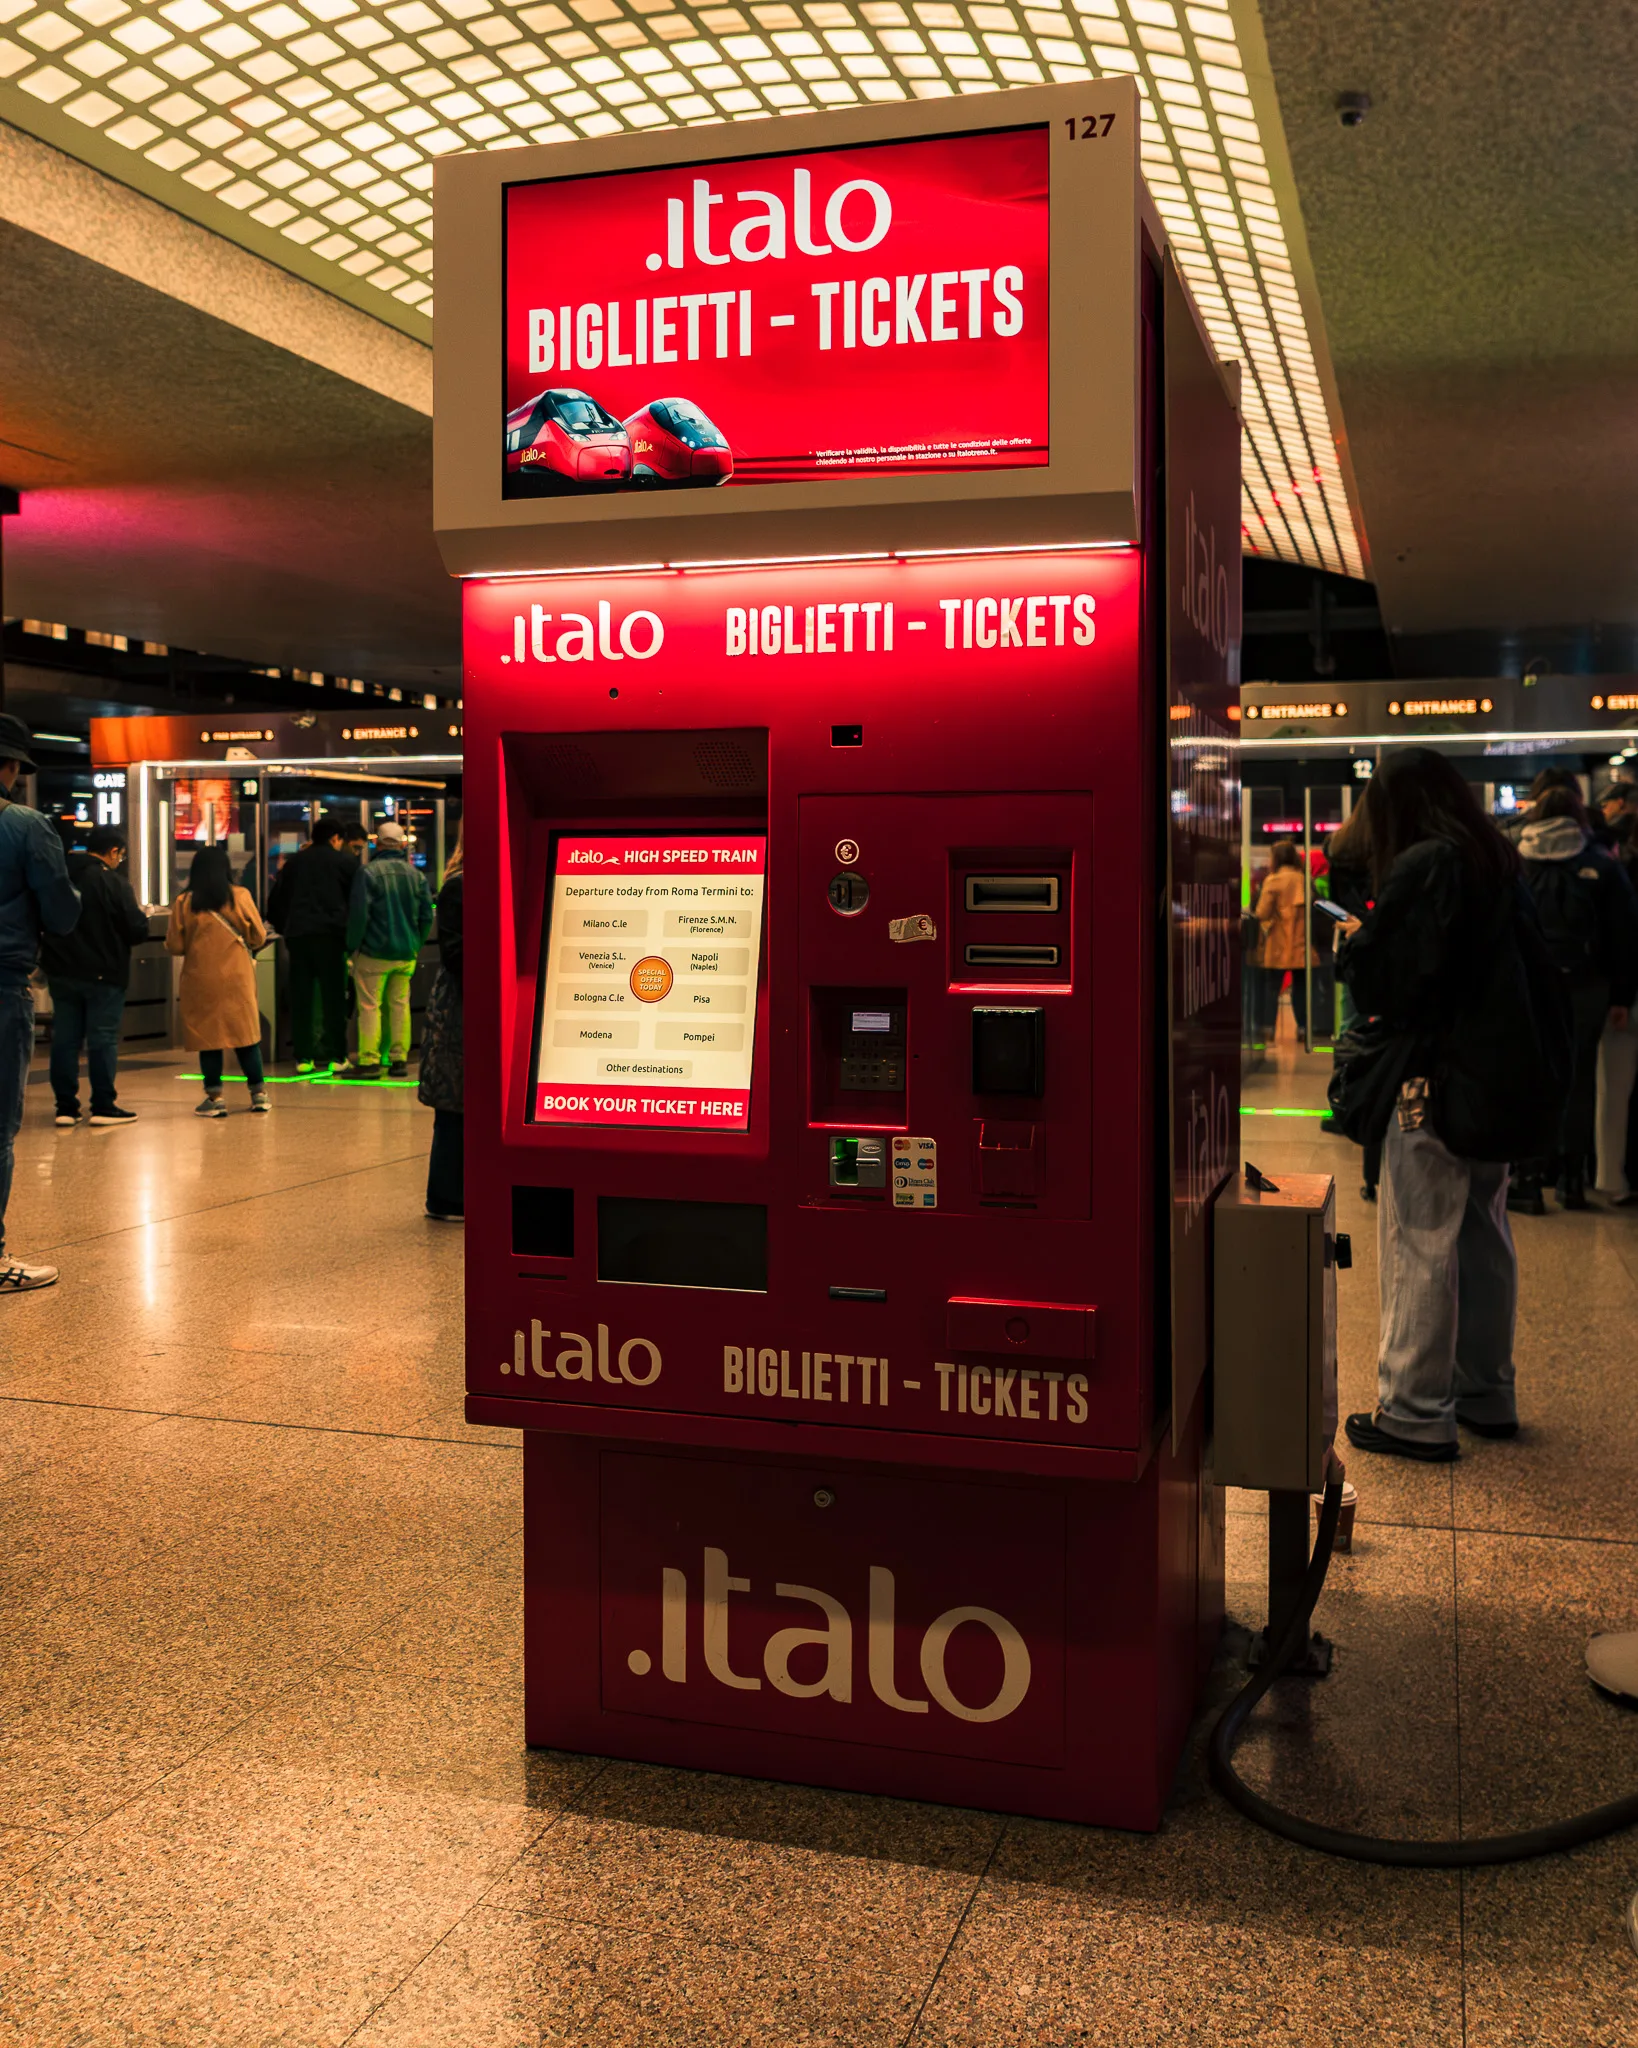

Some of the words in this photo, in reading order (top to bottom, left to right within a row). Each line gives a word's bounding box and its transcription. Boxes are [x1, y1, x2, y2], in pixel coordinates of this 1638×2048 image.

[1063, 113, 1116, 141] 127
[528, 289, 752, 374] BIGLIETTI
[811, 265, 1025, 350] TICKETS
[816, 449, 845, 458] Verificare
[888, 443, 926, 454] disponibilità
[958, 440, 991, 449] condizioni
[992, 439, 1008, 447] delle
[1009, 437, 1032, 446] offerte
[815, 457, 847, 466] chiedendo
[856, 455, 875, 463] nostro
[876, 453, 907, 463] personale
[908, 452, 915, 460] in
[915, 451, 941, 460] stazione
[726, 602, 894, 657] BIGLIETTI
[939, 594, 1096, 650] TICKETS
[1262, 704, 1332, 719] ENTRANCE
[1404, 699, 1477, 716] ENTRANCE
[353, 726, 407, 740] ENTRANCE
[93, 773, 126, 788] GATE
[97, 791, 121, 825] H
[624, 850, 659, 864] HIGH
[663, 849, 709, 864] SPEED
[712, 849, 758, 863] TRAIN
[566, 887, 614, 898] Departure
[616, 886, 644, 898] today
[645, 886, 669, 896] from
[672, 887, 699, 896] Roma
[702, 886, 738, 896] Termini
[740, 886, 754, 896] to:
[582, 919, 610, 928] Milano
[612, 919, 628, 929] C.le
[678, 915, 709, 925] Firenze
[710, 915, 737, 925] S.M.N.
[690, 926, 724, 934] (Florence)
[579, 952, 610, 961] Venezia
[612, 952, 626, 961] S.L.
[691, 953, 719, 963] Napoli
[588, 962, 615, 970] (Venice)
[638, 968, 667, 976] SPECIAL
[690, 963, 718, 972] (Naples)
[639, 984, 663, 992] TODAY
[574, 993, 607, 1004] Bologna
[608, 994, 625, 1003] C.le
[693, 995, 711, 1004] Pisa
[579, 1030, 613, 1040] Modena
[683, 1032, 715, 1043] Pompei
[606, 1063, 630, 1073] Other
[632, 1064, 684, 1075] destinations
[543, 1095, 590, 1111] BOOK
[593, 1096, 637, 1113] YOUR
[640, 1098, 697, 1115] TICKET
[700, 1101, 744, 1116] HERE
[918, 1142, 935, 1150] VISA
[723, 1345, 889, 1406] BIGLIETTI
[934, 1361, 1089, 1424] TICKETS
